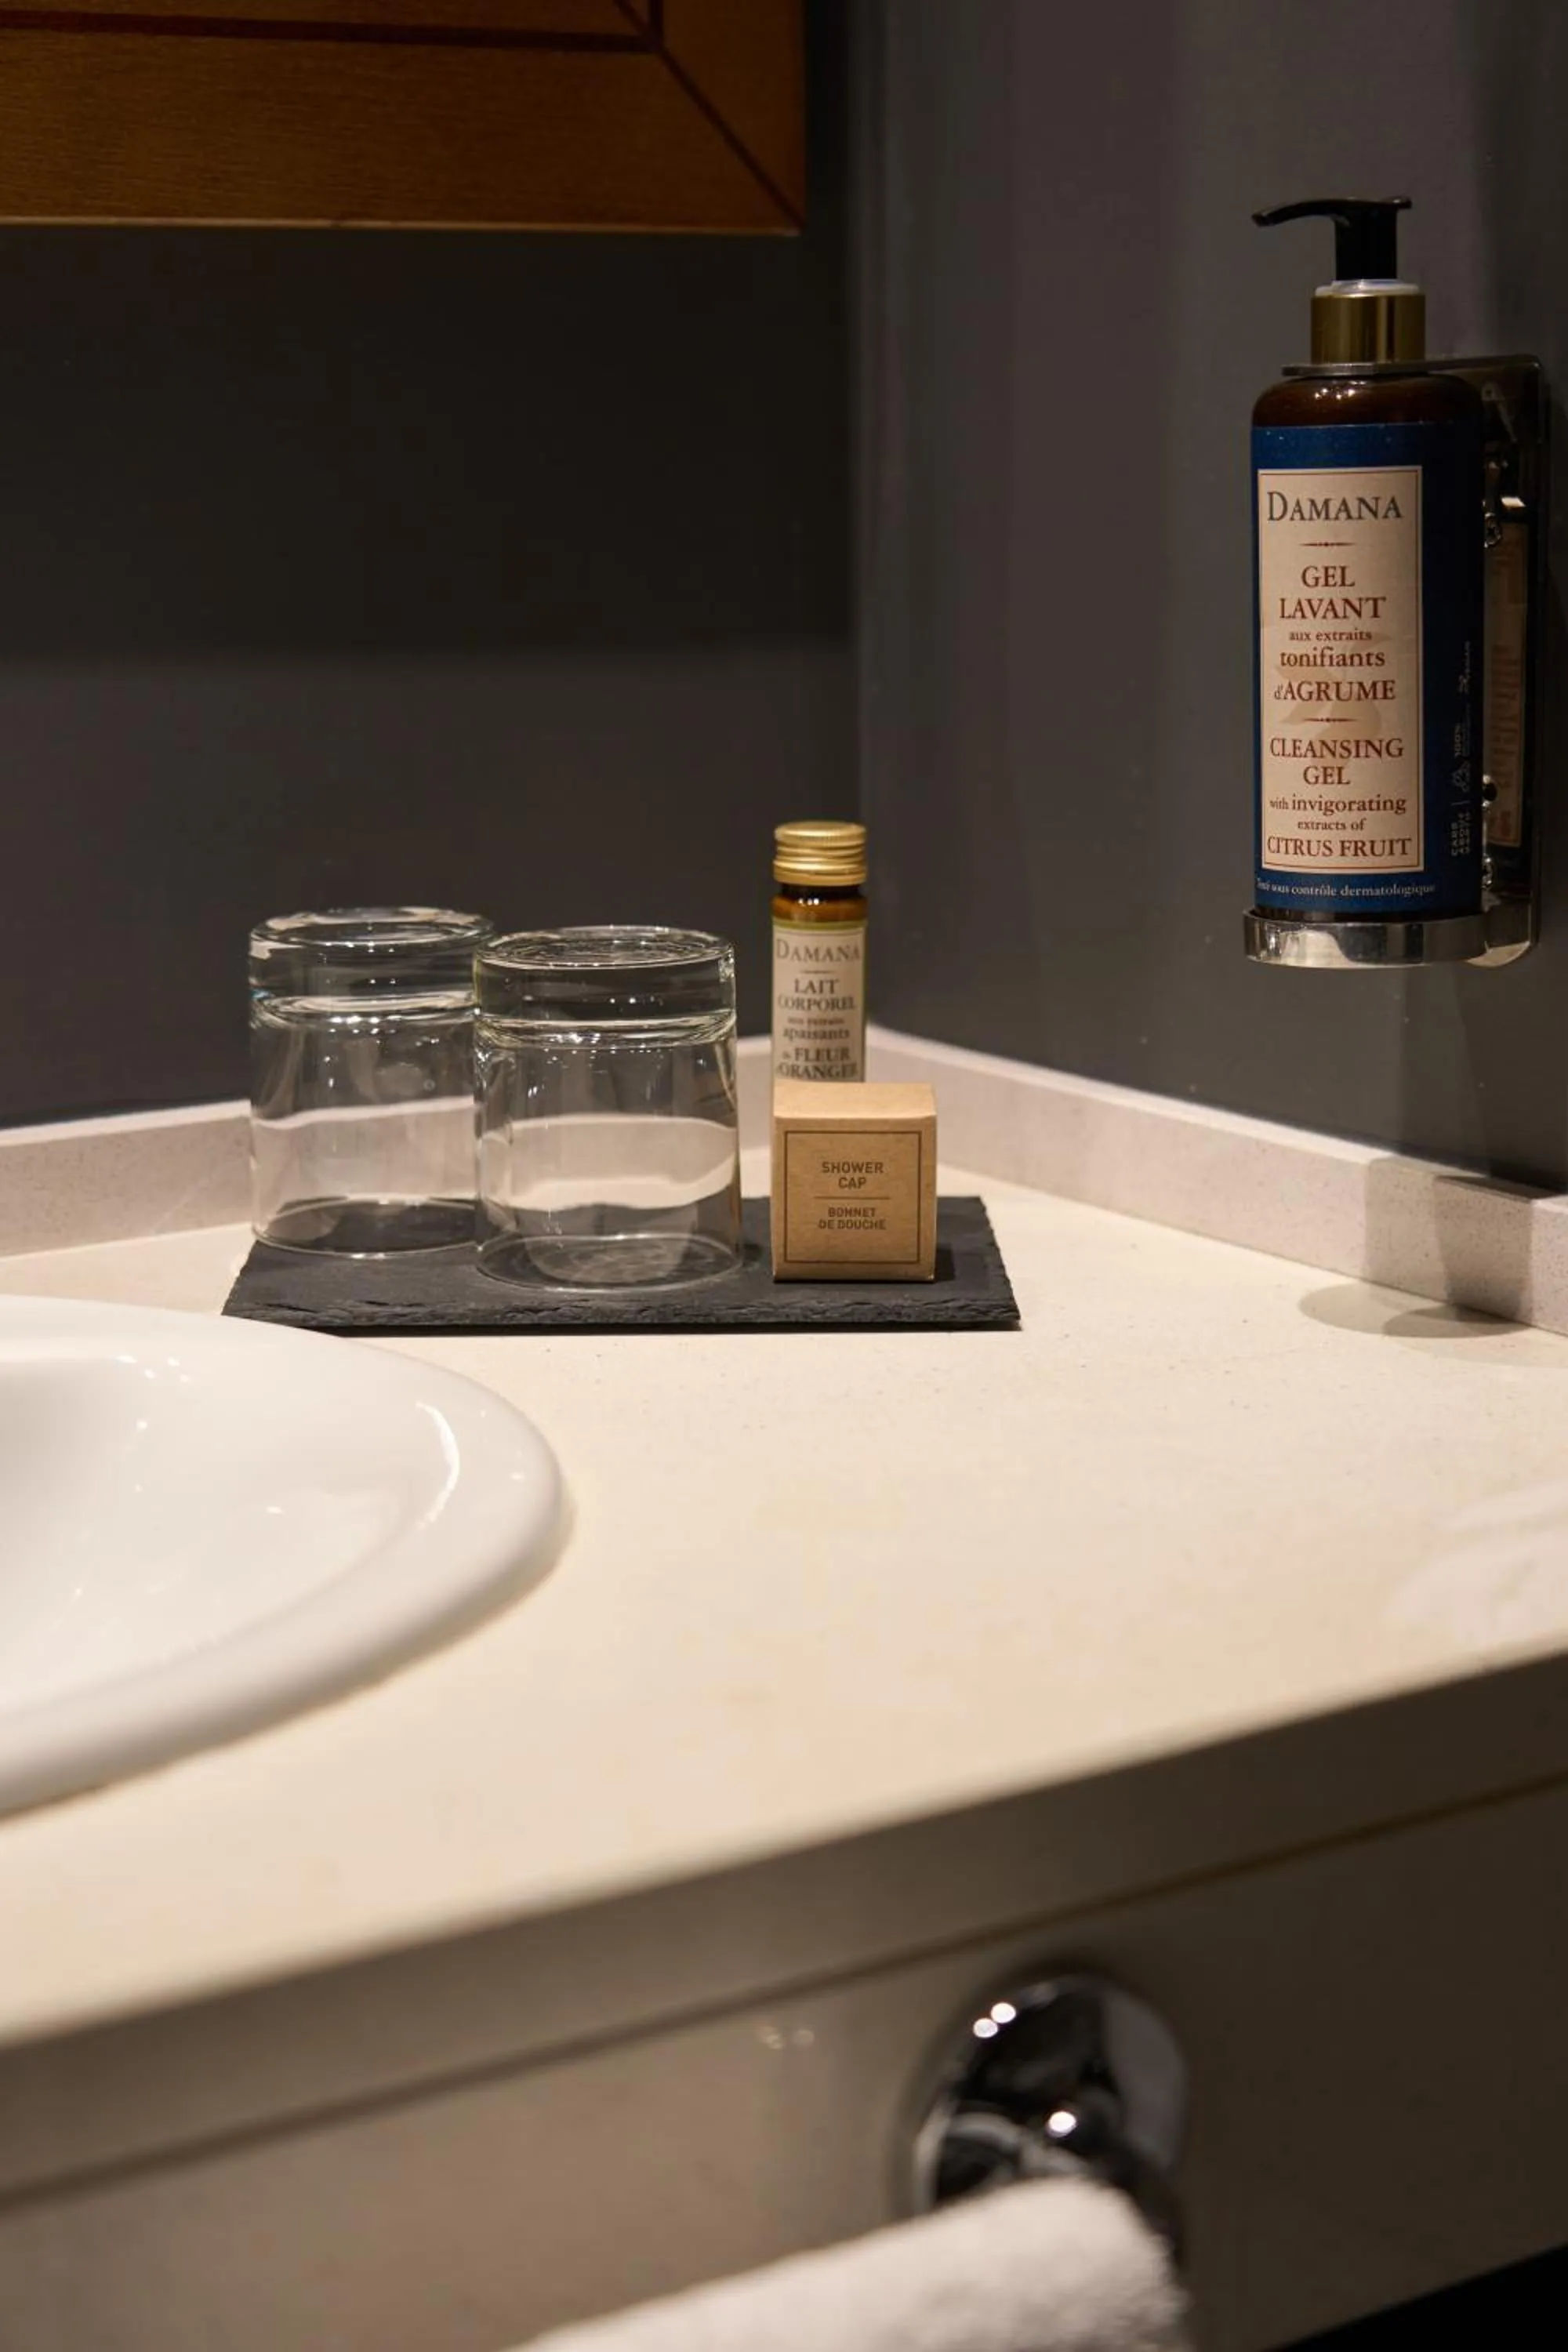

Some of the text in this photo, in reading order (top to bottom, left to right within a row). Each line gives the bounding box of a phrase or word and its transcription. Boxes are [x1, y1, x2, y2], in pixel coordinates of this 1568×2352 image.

[1267, 492, 1402, 521] DAMANA
[1301, 565, 1355, 589] GEL
[1279, 596, 1386, 619] LAVANT
[1289, 628, 1372, 641] aux extraits
[1280, 646, 1385, 667] tonifiants
[1274, 680, 1396, 701] d'AGRUME
[1270, 738, 1403, 760] CLEANSING
[1303, 765, 1351, 786] GEL
[1269, 793, 1406, 816] with invigorating
[1298, 818, 1367, 831] extracts of
[1267, 836, 1412, 857] CITRUS FRUIT
[1291, 884, 1338, 897] contrôle
[1340, 882, 1436, 898] dermatologique
[776, 938, 861, 963] DAMANA
[793, 978, 840, 995] LAIT
[793, 1047, 850, 1062] FLEUR
[822, 1161, 884, 1174] SHOWER
[837, 1176, 867, 1189] CAP
[827, 1207, 877, 1218] BONNET
[817, 1219, 887, 1230] DE DOUCHE
